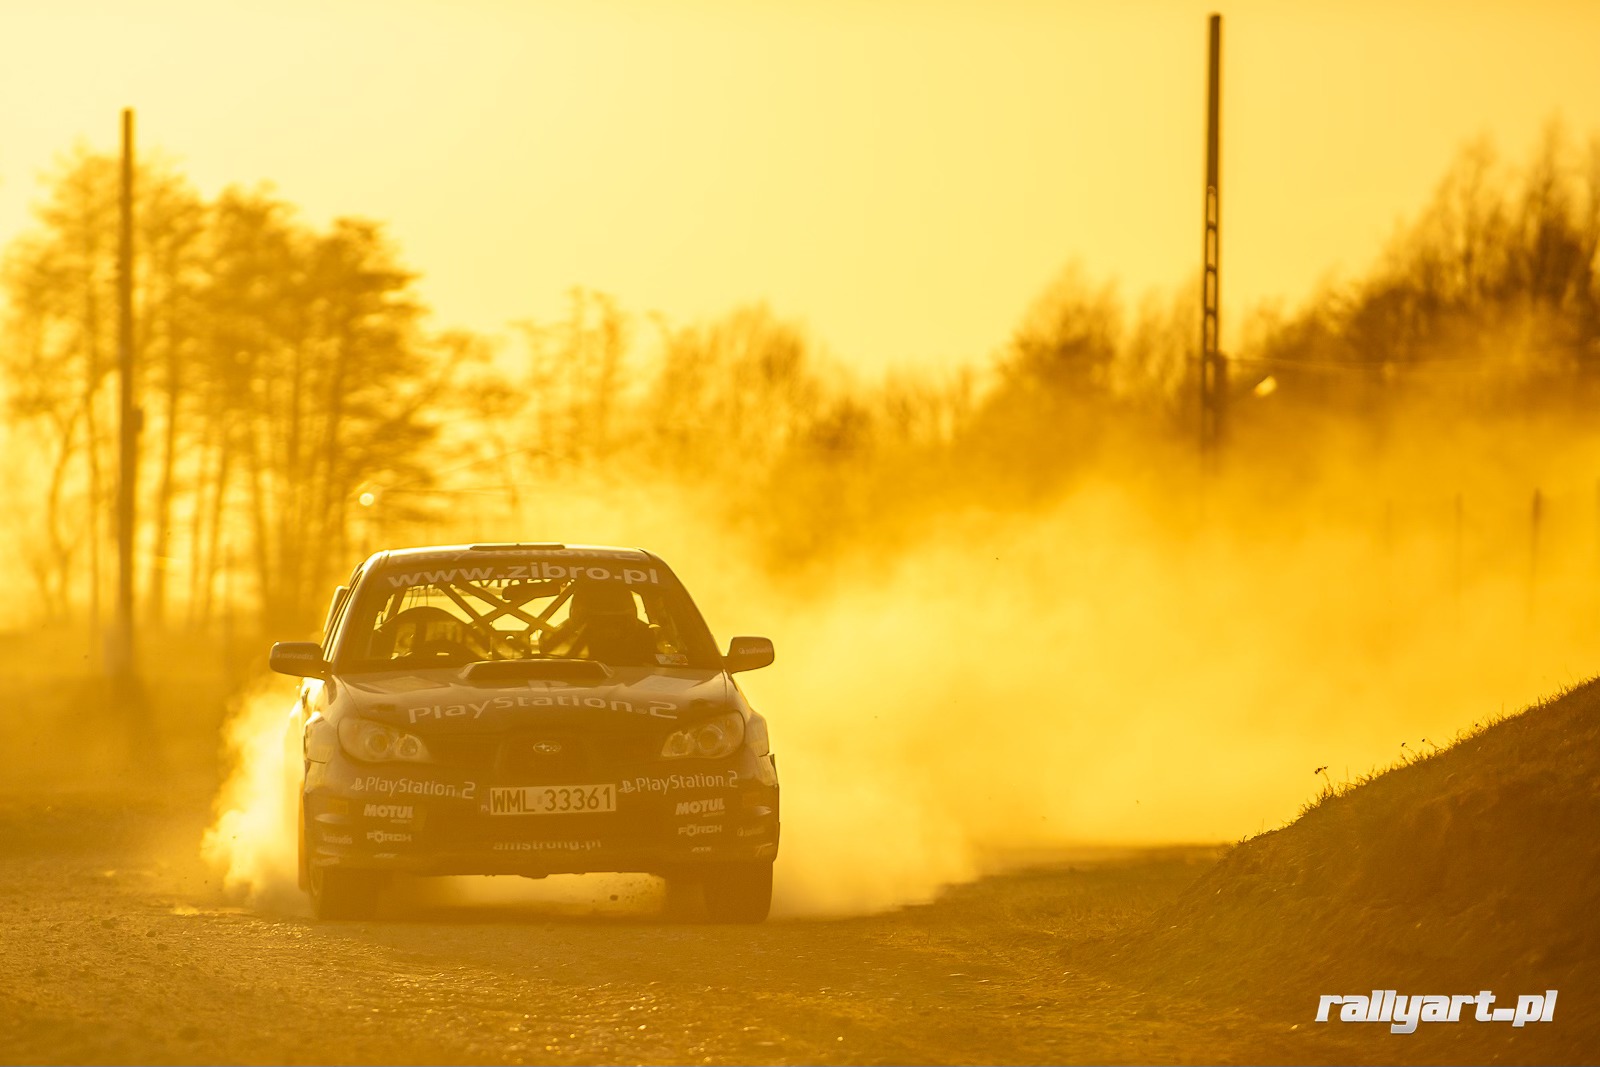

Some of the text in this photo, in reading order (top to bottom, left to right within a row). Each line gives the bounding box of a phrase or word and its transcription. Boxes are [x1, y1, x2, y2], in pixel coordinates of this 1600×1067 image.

[387, 562, 659, 587] www.zibro.pl
[408, 696, 640, 724] PlayStation
[365, 777, 455, 797] PlayStation
[635, 773, 724, 795] PlayStation
[363, 803, 414, 819] MOTUL
[491, 787, 611, 813] WML 33361
[675, 798, 725, 815] MOTUL
